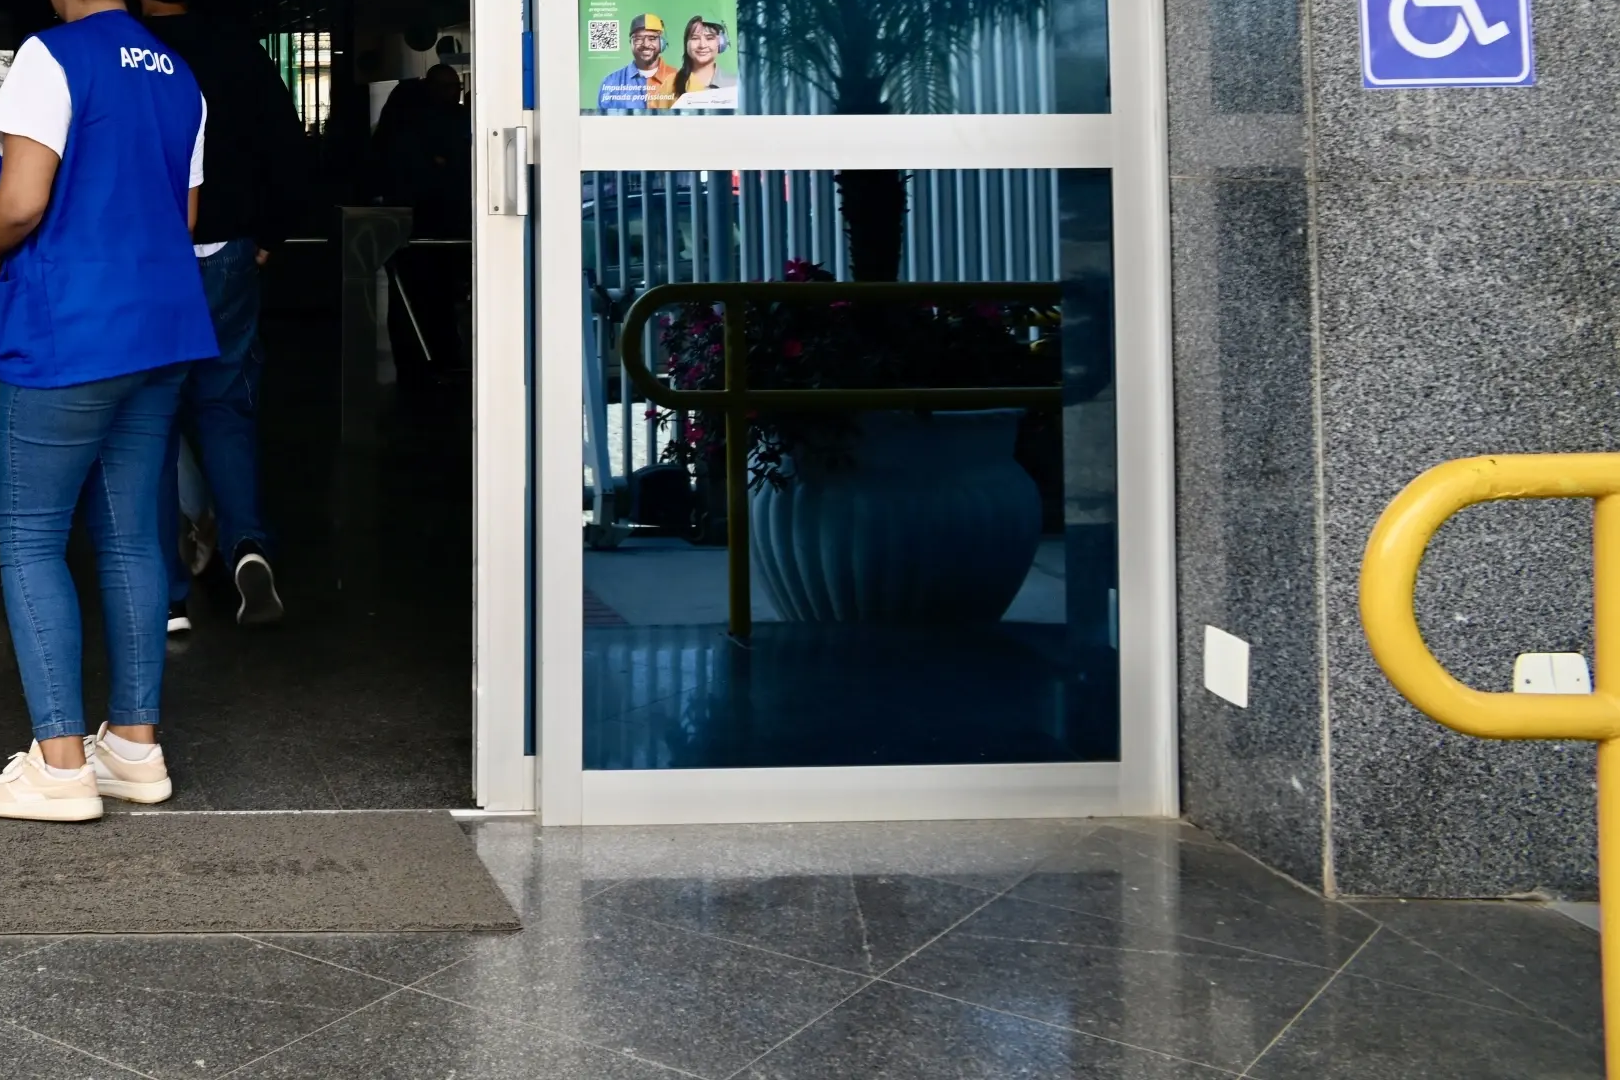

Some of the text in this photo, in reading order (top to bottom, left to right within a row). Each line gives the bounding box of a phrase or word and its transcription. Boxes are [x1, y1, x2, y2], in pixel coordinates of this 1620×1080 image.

[120, 46, 174, 75] APOIO
[602, 84, 642, 92] Impulsione
[601, 93, 675, 102] jornada profissional
